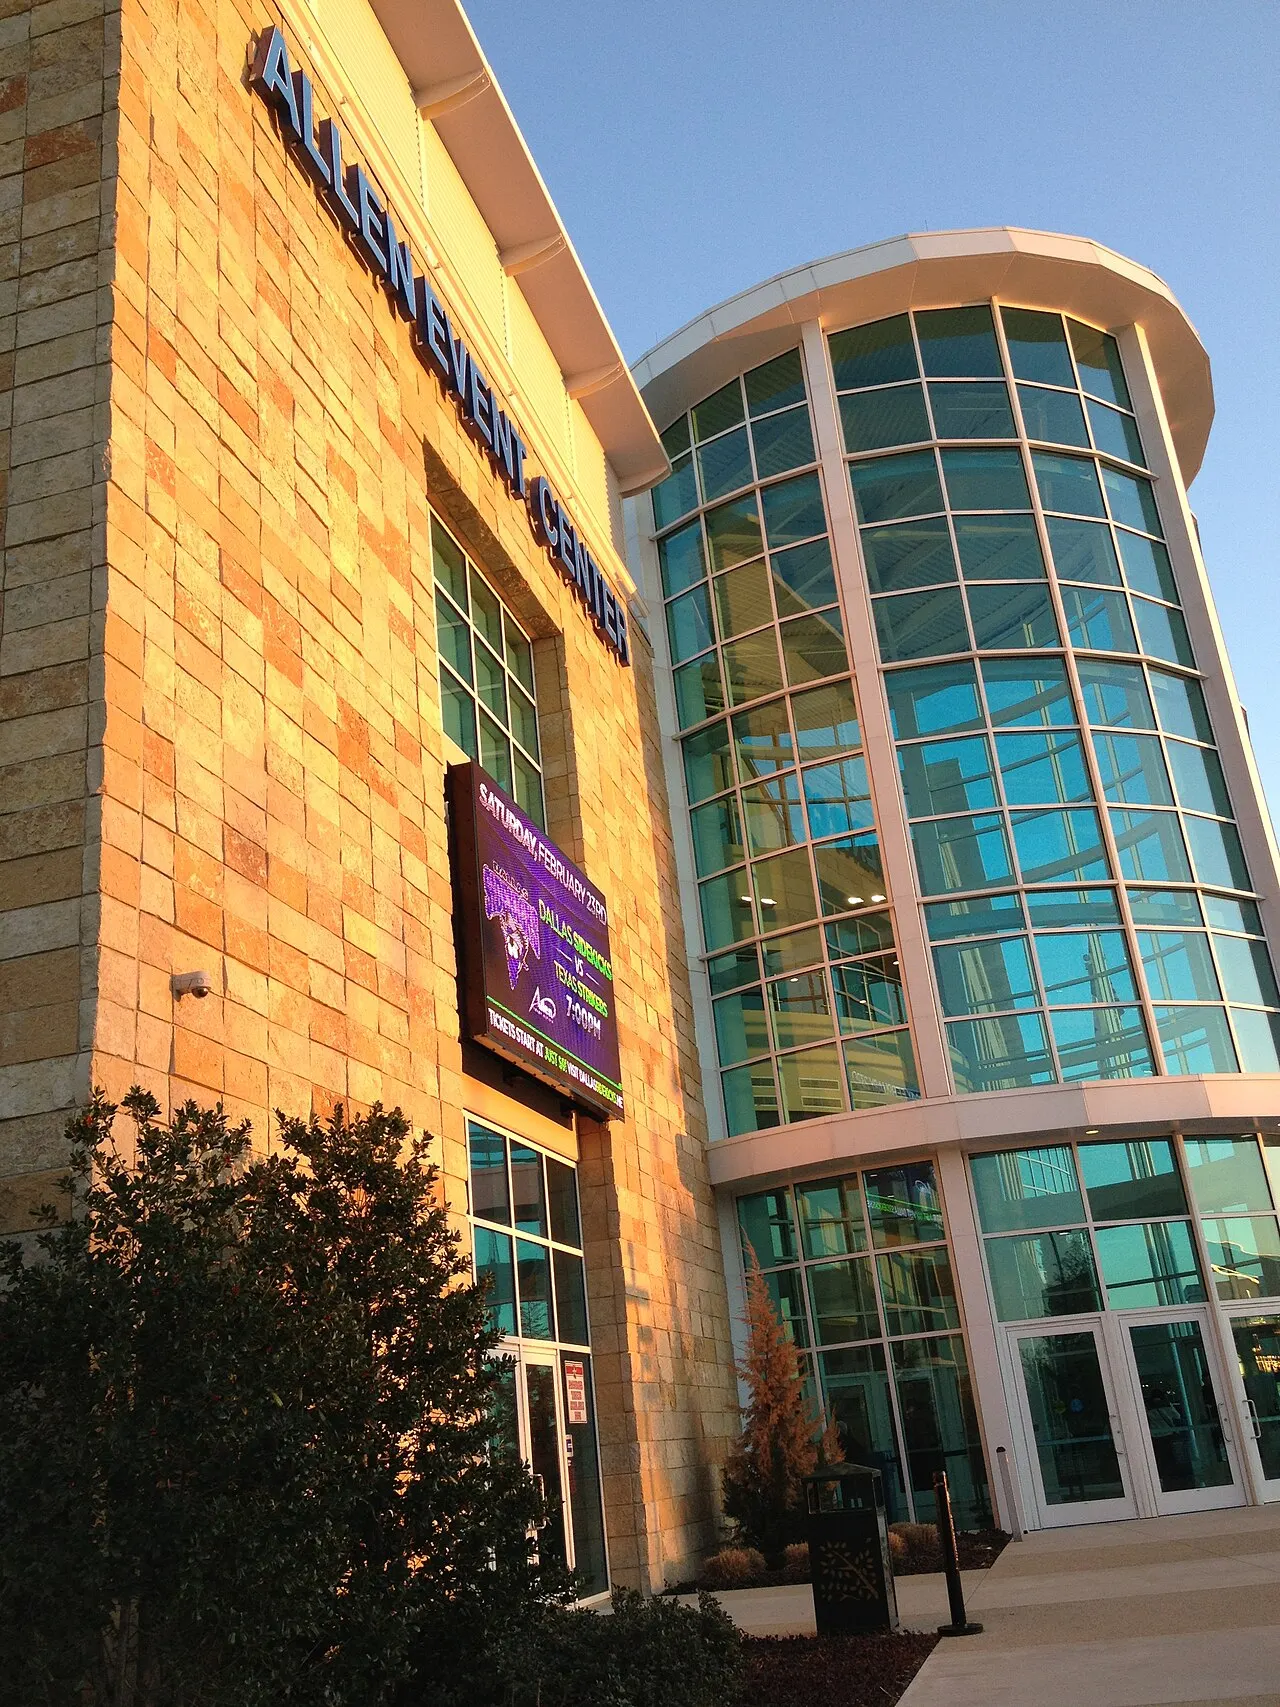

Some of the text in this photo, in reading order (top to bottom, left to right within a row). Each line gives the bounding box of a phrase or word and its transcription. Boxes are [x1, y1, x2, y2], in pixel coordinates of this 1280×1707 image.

[250, 25, 629, 666] ALLEN EVENT CENTER
[479, 783, 607, 925] SATURDAY, FEBRUARY 23RD
[538, 899, 613, 981] DALLAS SIDEKICKS
[574, 955, 584, 977] VS
[553, 959, 577, 993] TEXAS
[577, 981, 608, 1018] STRIKERS
[565, 994, 601, 1040] 7:00PM
[488, 1007, 516, 1040] TICKETS
[515, 1026, 536, 1053] START
[535, 1040, 544, 1058] AT
[544, 1046, 558, 1066] JUST
[567, 1062, 579, 1080] VISIT
